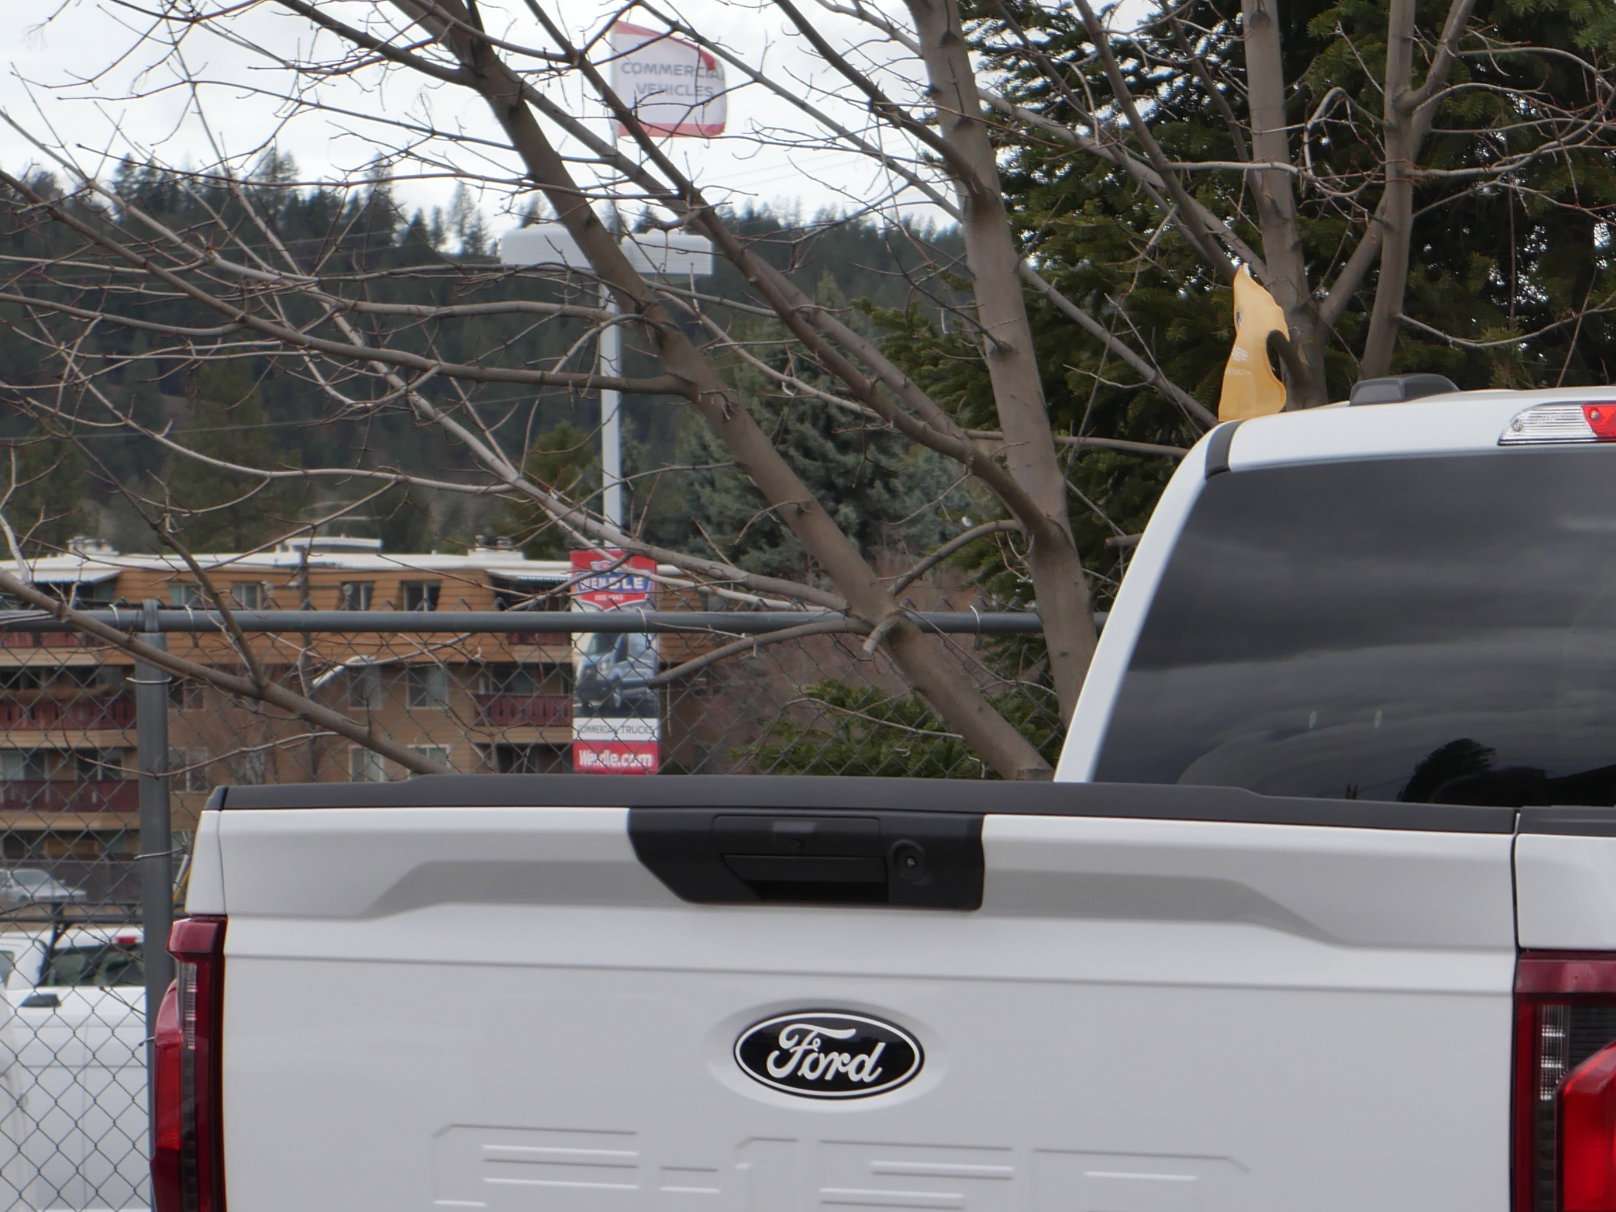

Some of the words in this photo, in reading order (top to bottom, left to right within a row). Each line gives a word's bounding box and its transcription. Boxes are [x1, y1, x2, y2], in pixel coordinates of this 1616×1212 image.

[635, 83, 714, 98] VEHICLES
[580, 577, 644, 590] WENDLE
[766, 1023, 886, 1083] Ford
